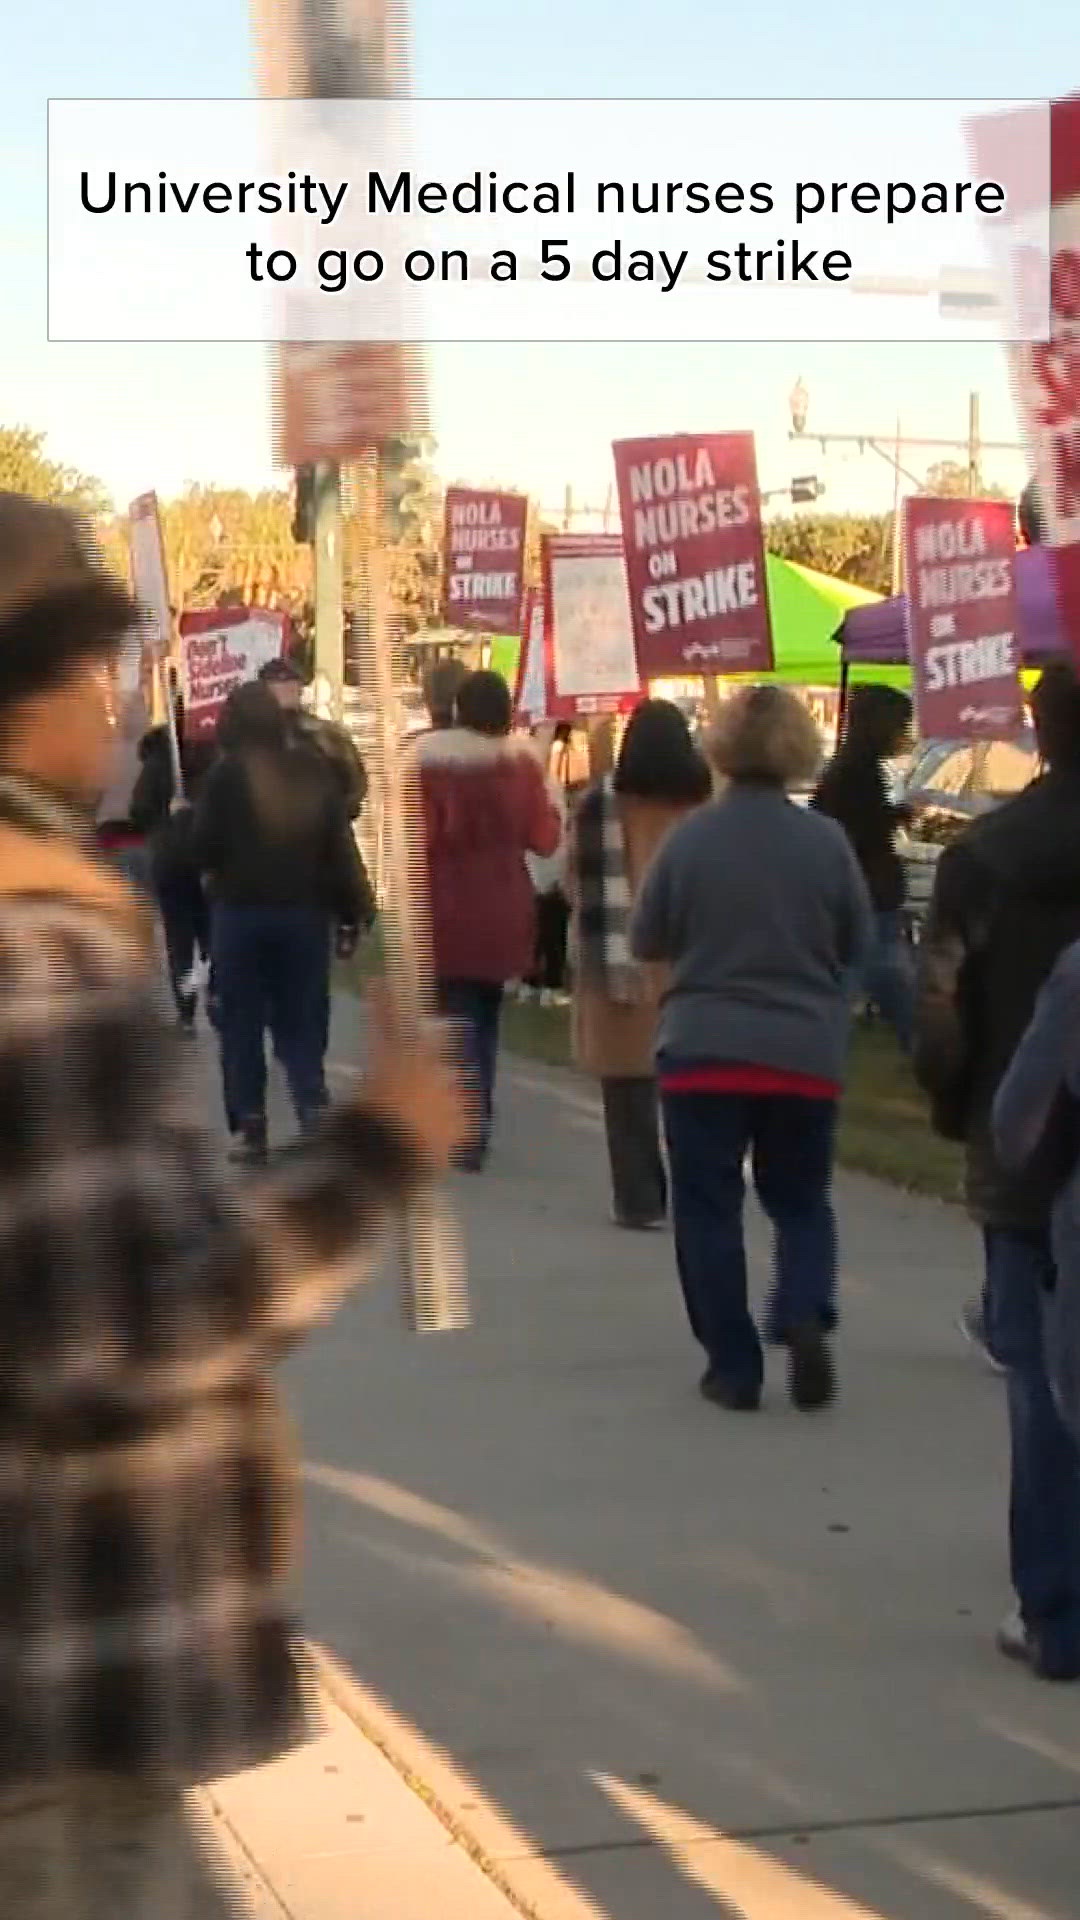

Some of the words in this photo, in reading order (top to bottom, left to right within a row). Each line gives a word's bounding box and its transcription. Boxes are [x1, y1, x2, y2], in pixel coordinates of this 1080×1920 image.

[629, 447, 716, 503] NOLA
[450, 500, 503, 526] NOLA
[633, 485, 750, 549] NURSES
[450, 526, 521, 551] NURSES
[914, 516, 986, 562] NOLA
[449, 572, 518, 600] STRIKE
[648, 551, 677, 579] ON
[919, 558, 1013, 608] NURSES
[642, 563, 759, 633] STRIKE
[925, 632, 1016, 691] STRIKE
